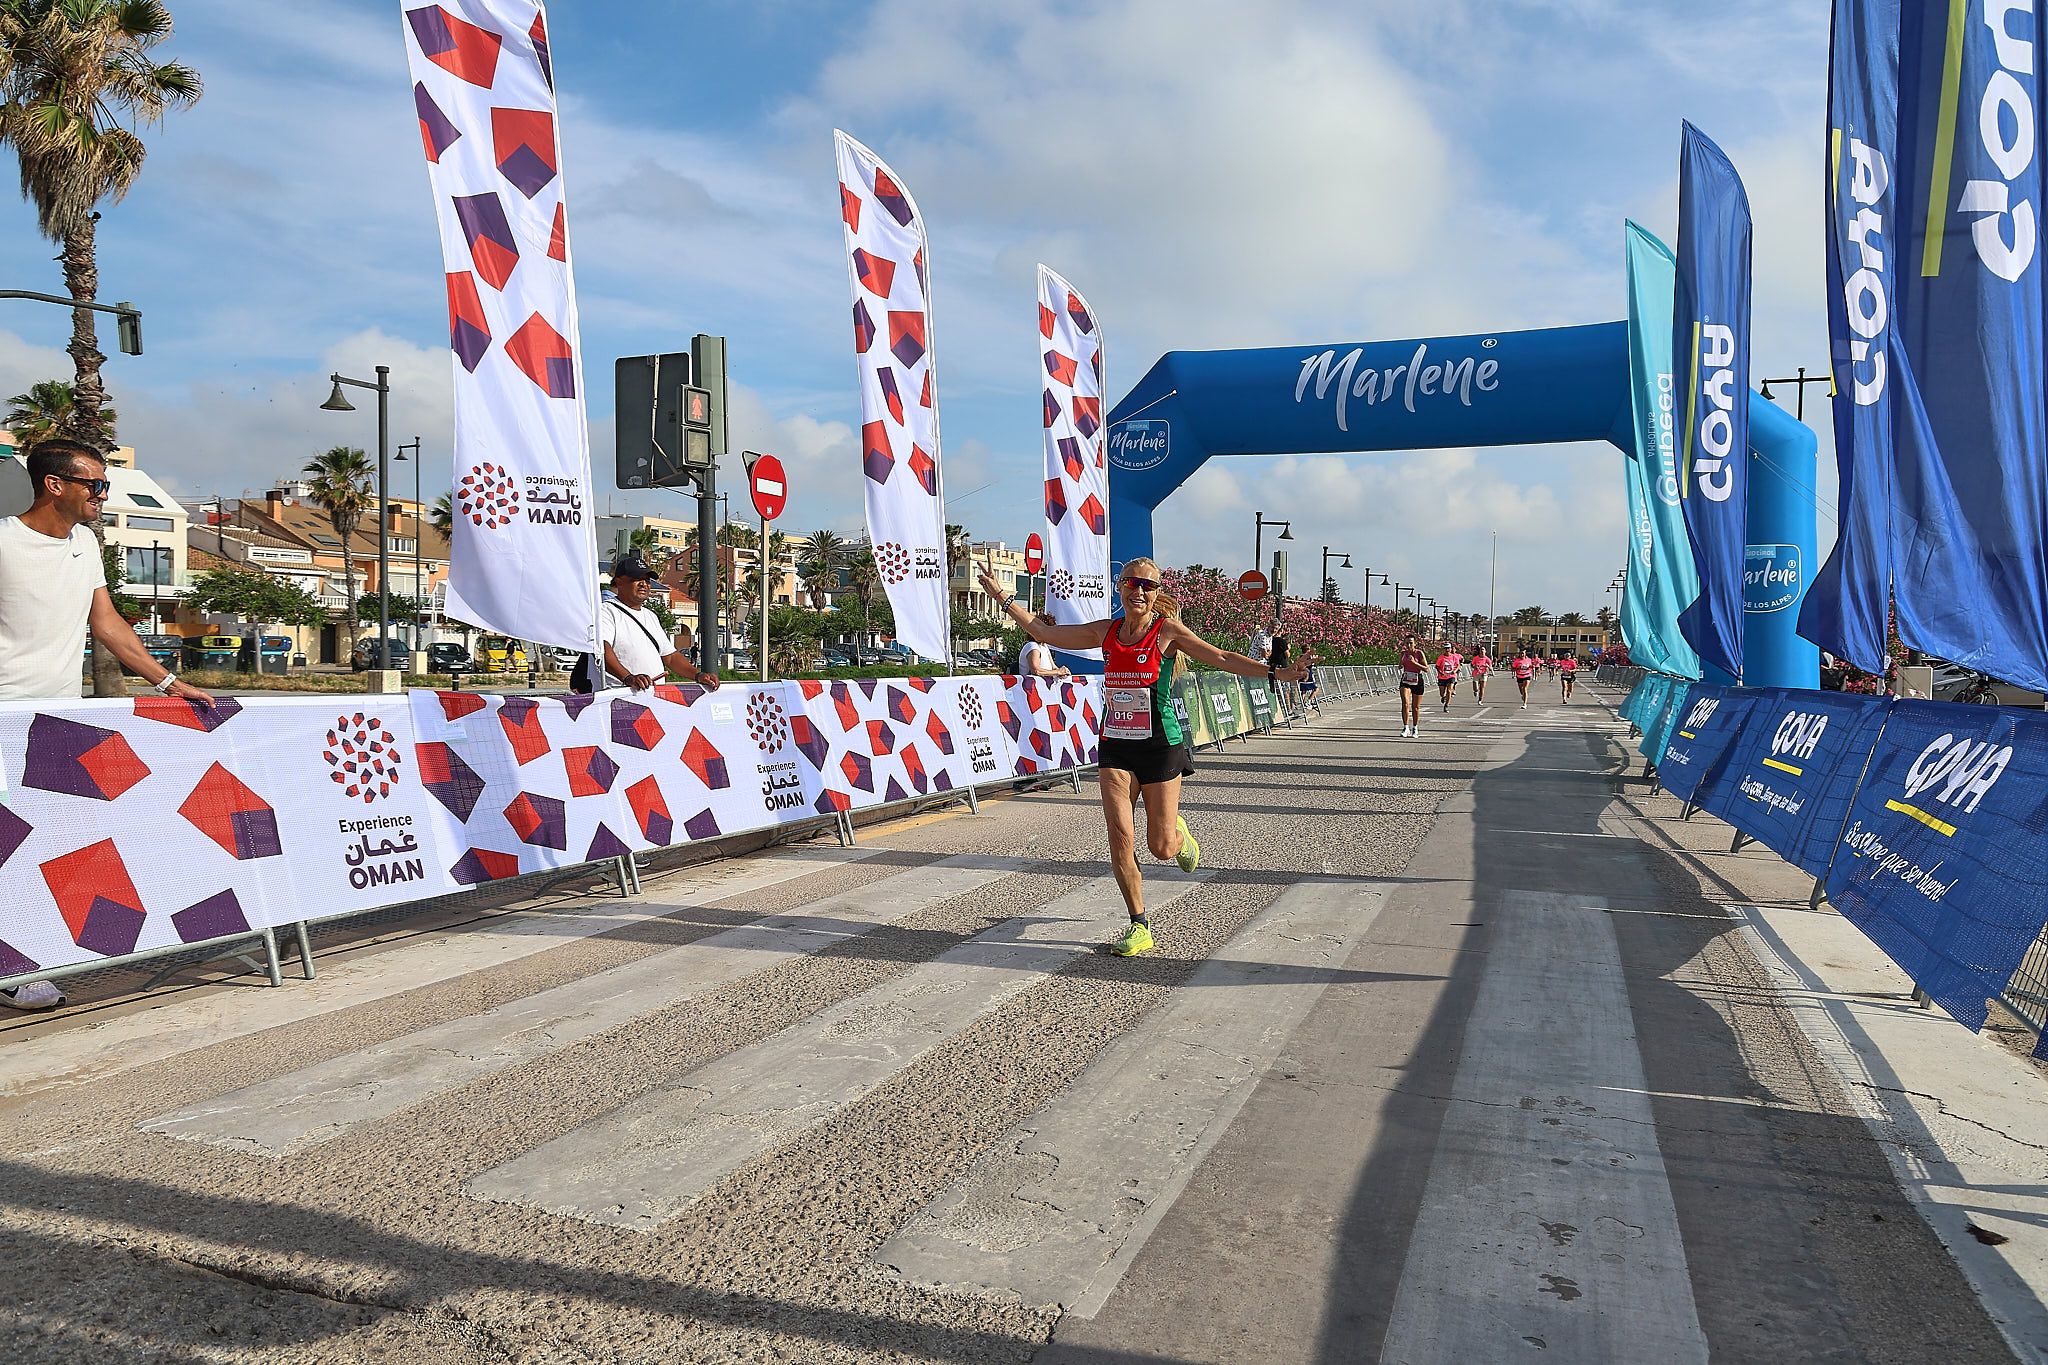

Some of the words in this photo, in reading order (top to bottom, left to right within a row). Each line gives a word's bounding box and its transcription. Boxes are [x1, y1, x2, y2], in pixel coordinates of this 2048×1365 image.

[1295, 343, 1499, 431] Marlene
[1110, 431, 1165, 457] Marlene
[1144, 456, 1161, 466] ALPES
[1744, 560, 1797, 588] arlene
[1771, 593, 1792, 607] ALPES
[1114, 711, 1133, 720] 016
[1684, 697, 1720, 729] GOYA
[1771, 710, 1829, 760] GOYA
[756, 761, 796, 775] Experience
[972, 759, 997, 773] OMAN
[1903, 733, 2013, 814] GOYA
[765, 791, 805, 812] OMAN
[338, 814, 413, 835] Experience
[348, 858, 425, 890] OMAN
[1869, 852, 1908, 880] que
[1900, 864, 1924, 884] ser
[1915, 860, 1958, 903] bueno!
